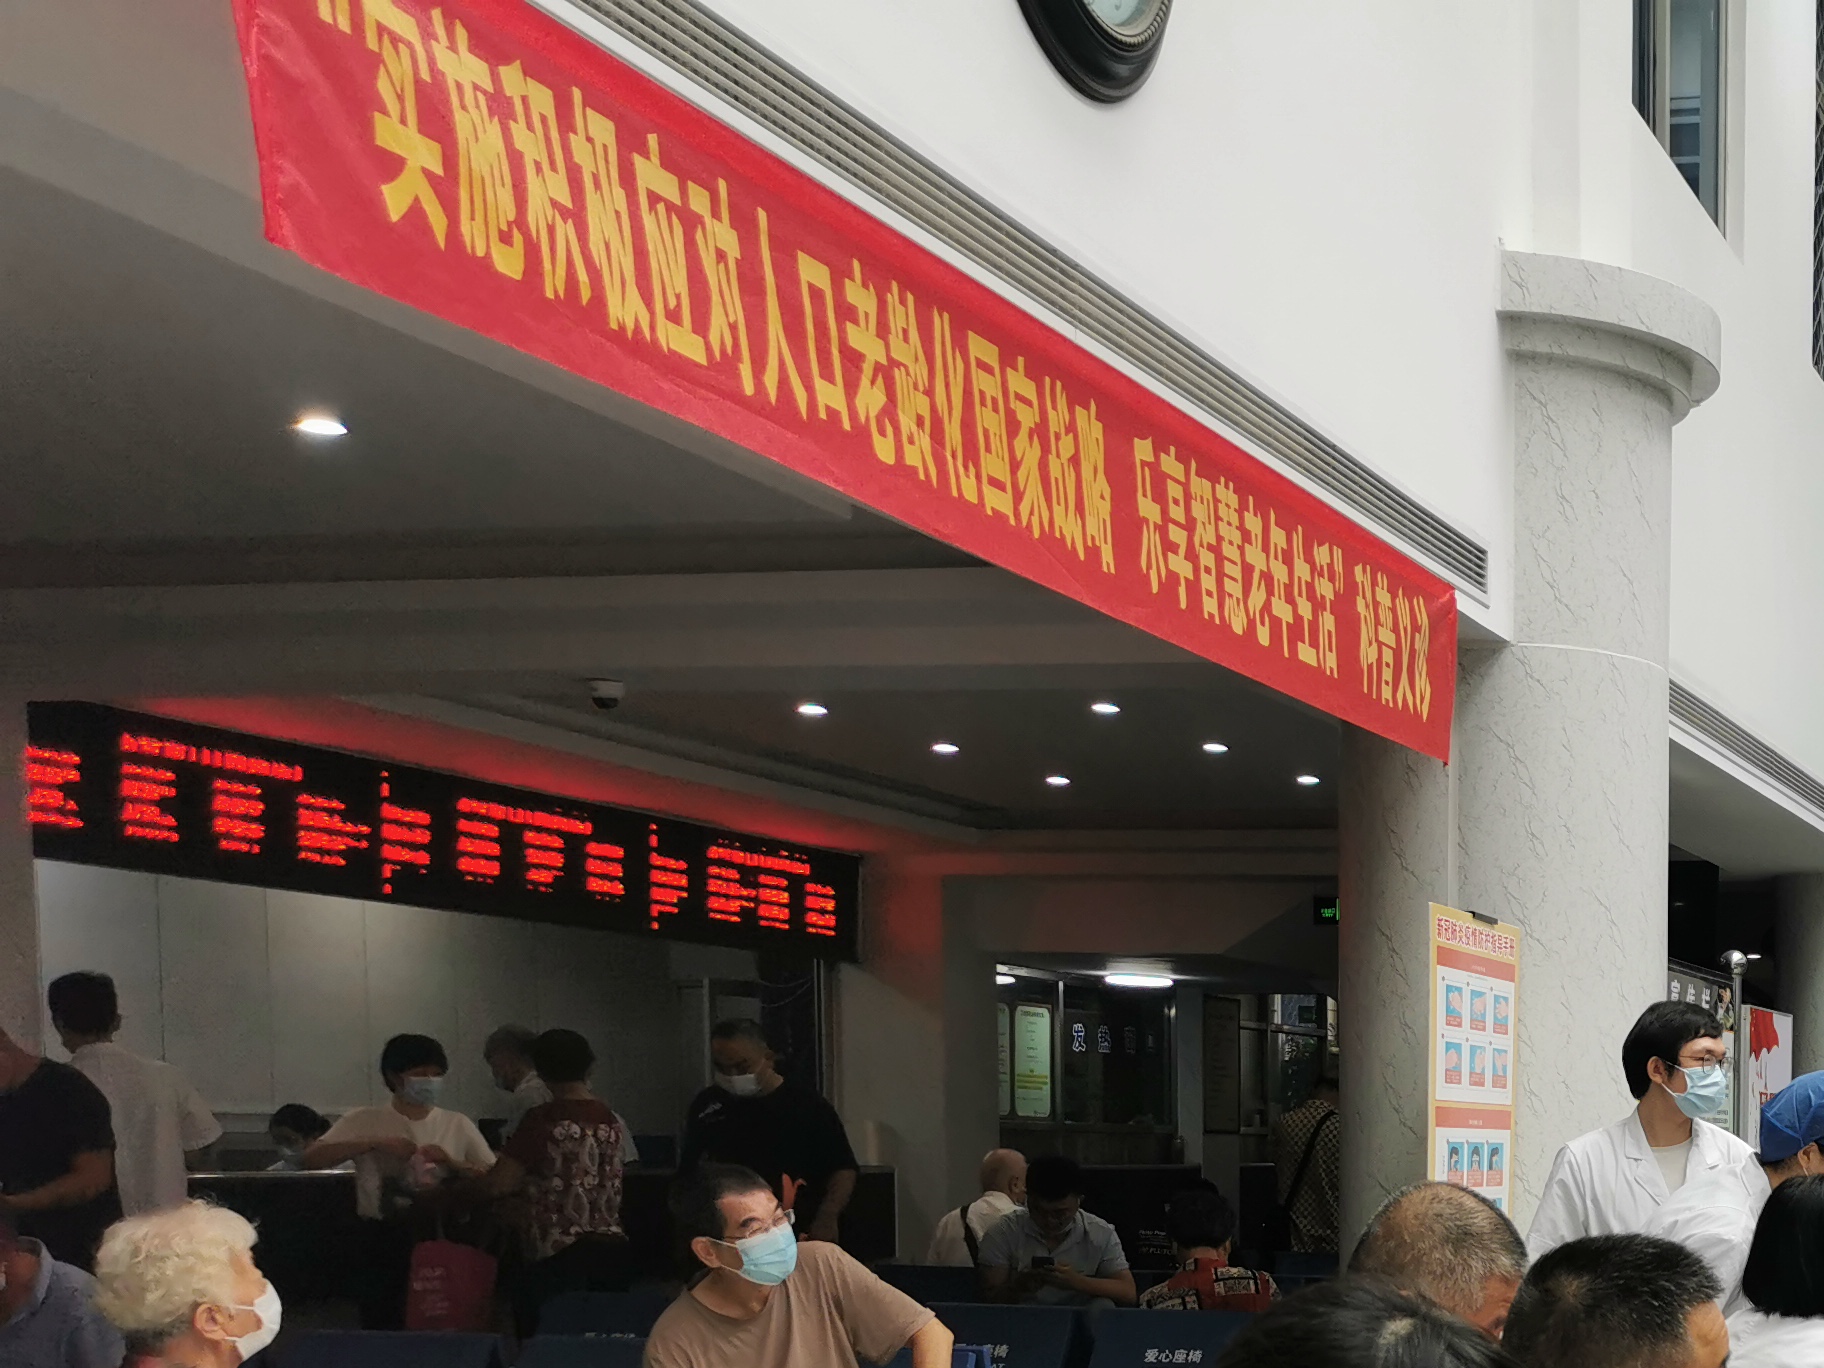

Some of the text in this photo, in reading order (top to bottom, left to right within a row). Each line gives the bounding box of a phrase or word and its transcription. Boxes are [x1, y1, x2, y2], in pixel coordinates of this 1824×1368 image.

[1354, 562, 1431, 723] 科普义诊
[1144, 1349, 1203, 1363] 爱心座椅
